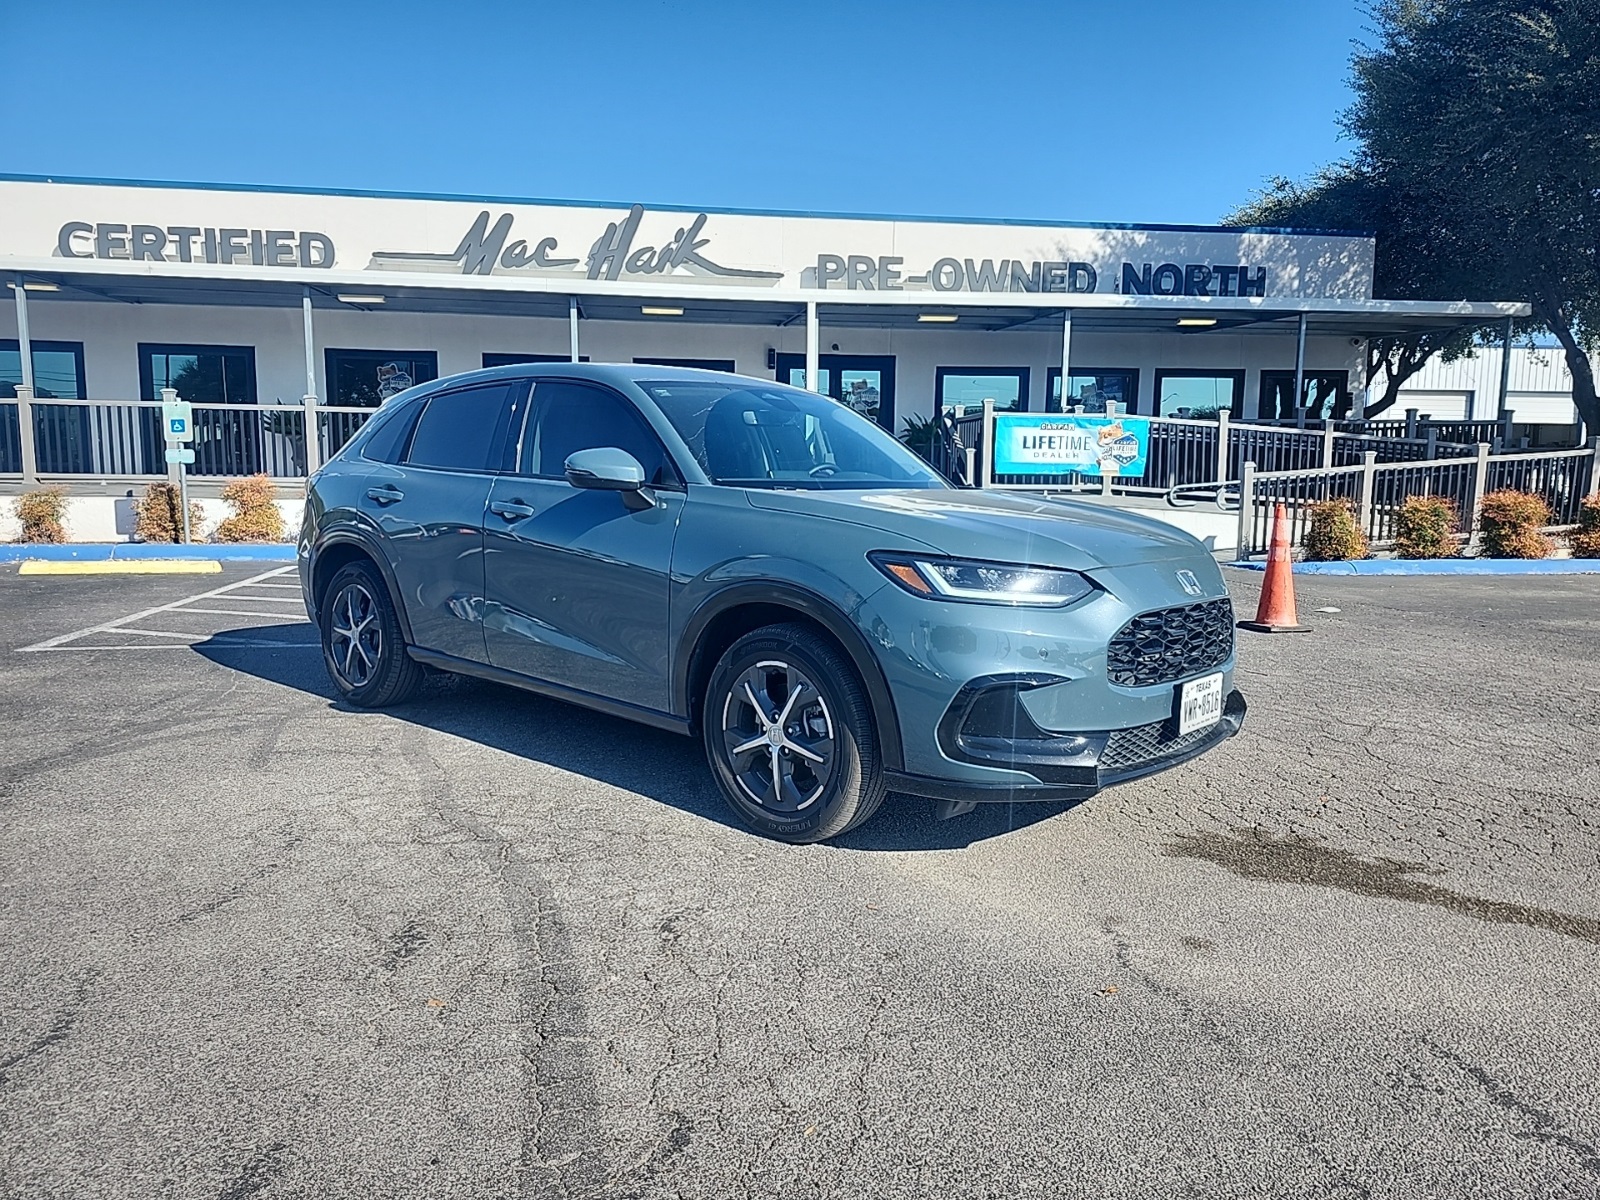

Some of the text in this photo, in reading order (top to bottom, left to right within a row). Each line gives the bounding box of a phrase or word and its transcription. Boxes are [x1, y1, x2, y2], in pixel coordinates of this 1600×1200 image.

[58, 221, 336, 269] CERTIFIED
[372, 203, 785, 281] Mac Haik
[816, 253, 1266, 298] PRE-OWNED NORTH
[1040, 423, 1075, 431] CARFAX
[1022, 435, 1092, 451] LIFETIME
[1033, 451, 1079, 459] DEALER
[1195, 680, 1211, 693] TEXAS
